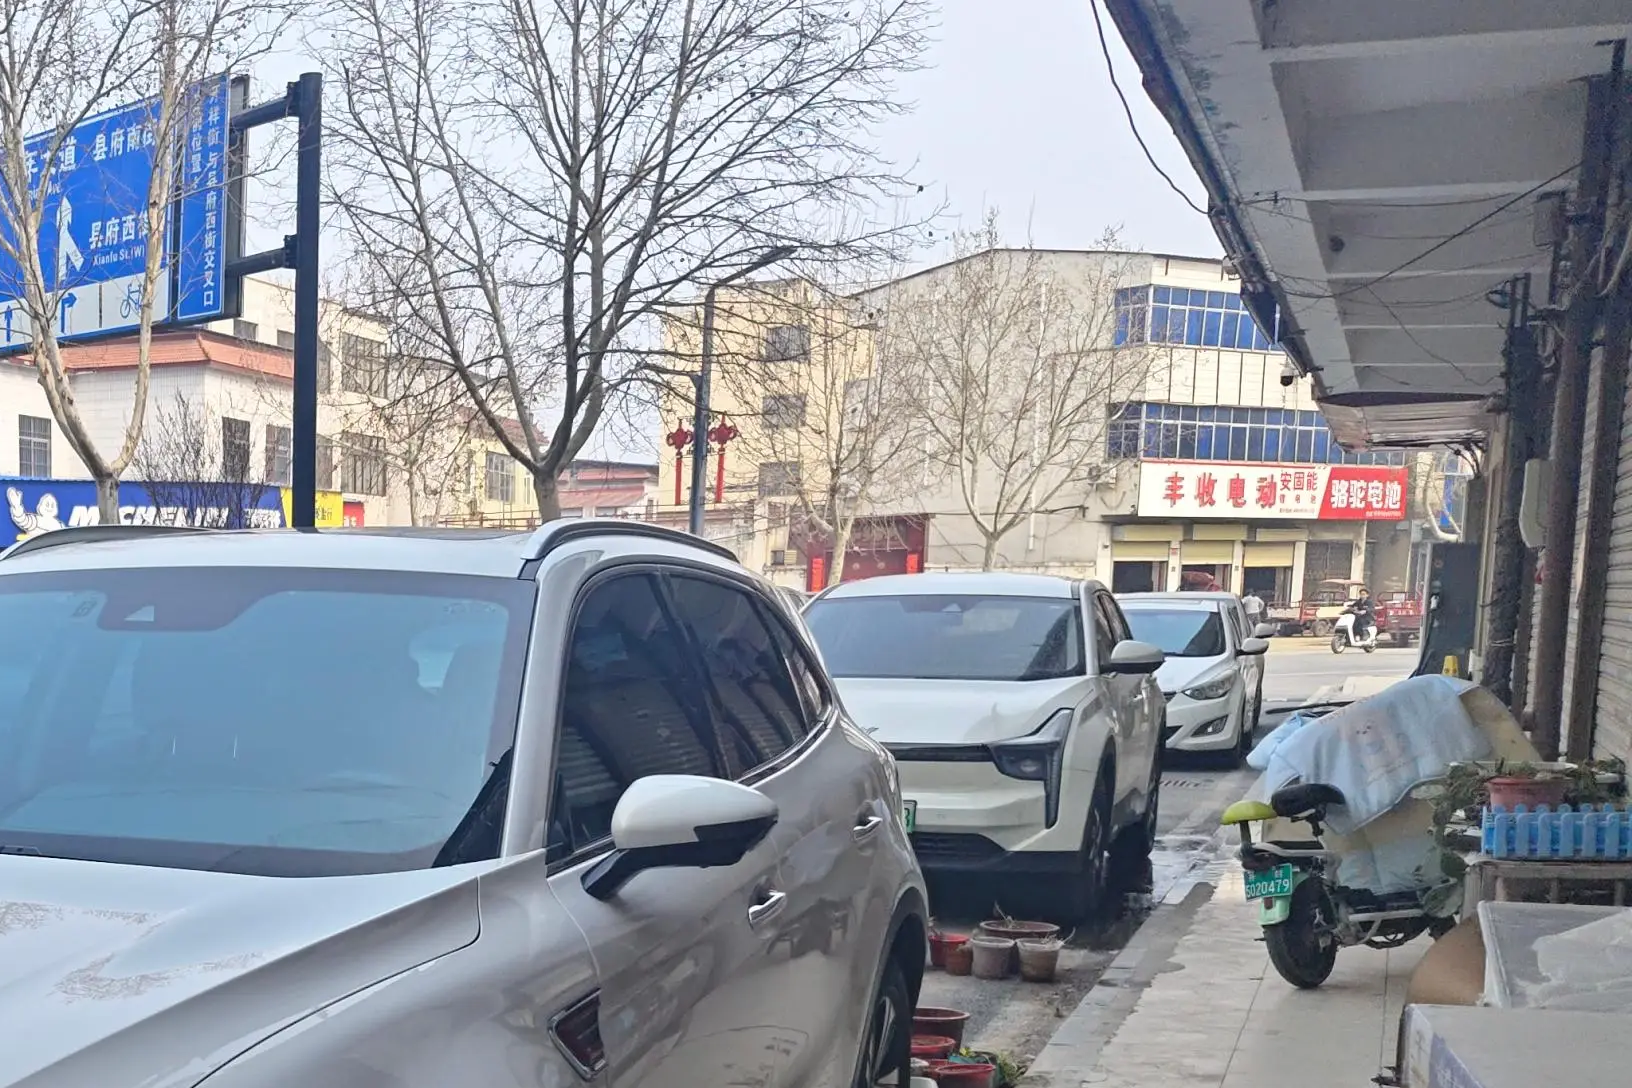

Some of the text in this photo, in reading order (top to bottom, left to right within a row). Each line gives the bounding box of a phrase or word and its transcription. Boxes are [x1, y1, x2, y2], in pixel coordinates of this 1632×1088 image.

[1163, 472, 1402, 509] 丰收电动 骆驼电池
[69, 506, 229, 527] MCHELIN
